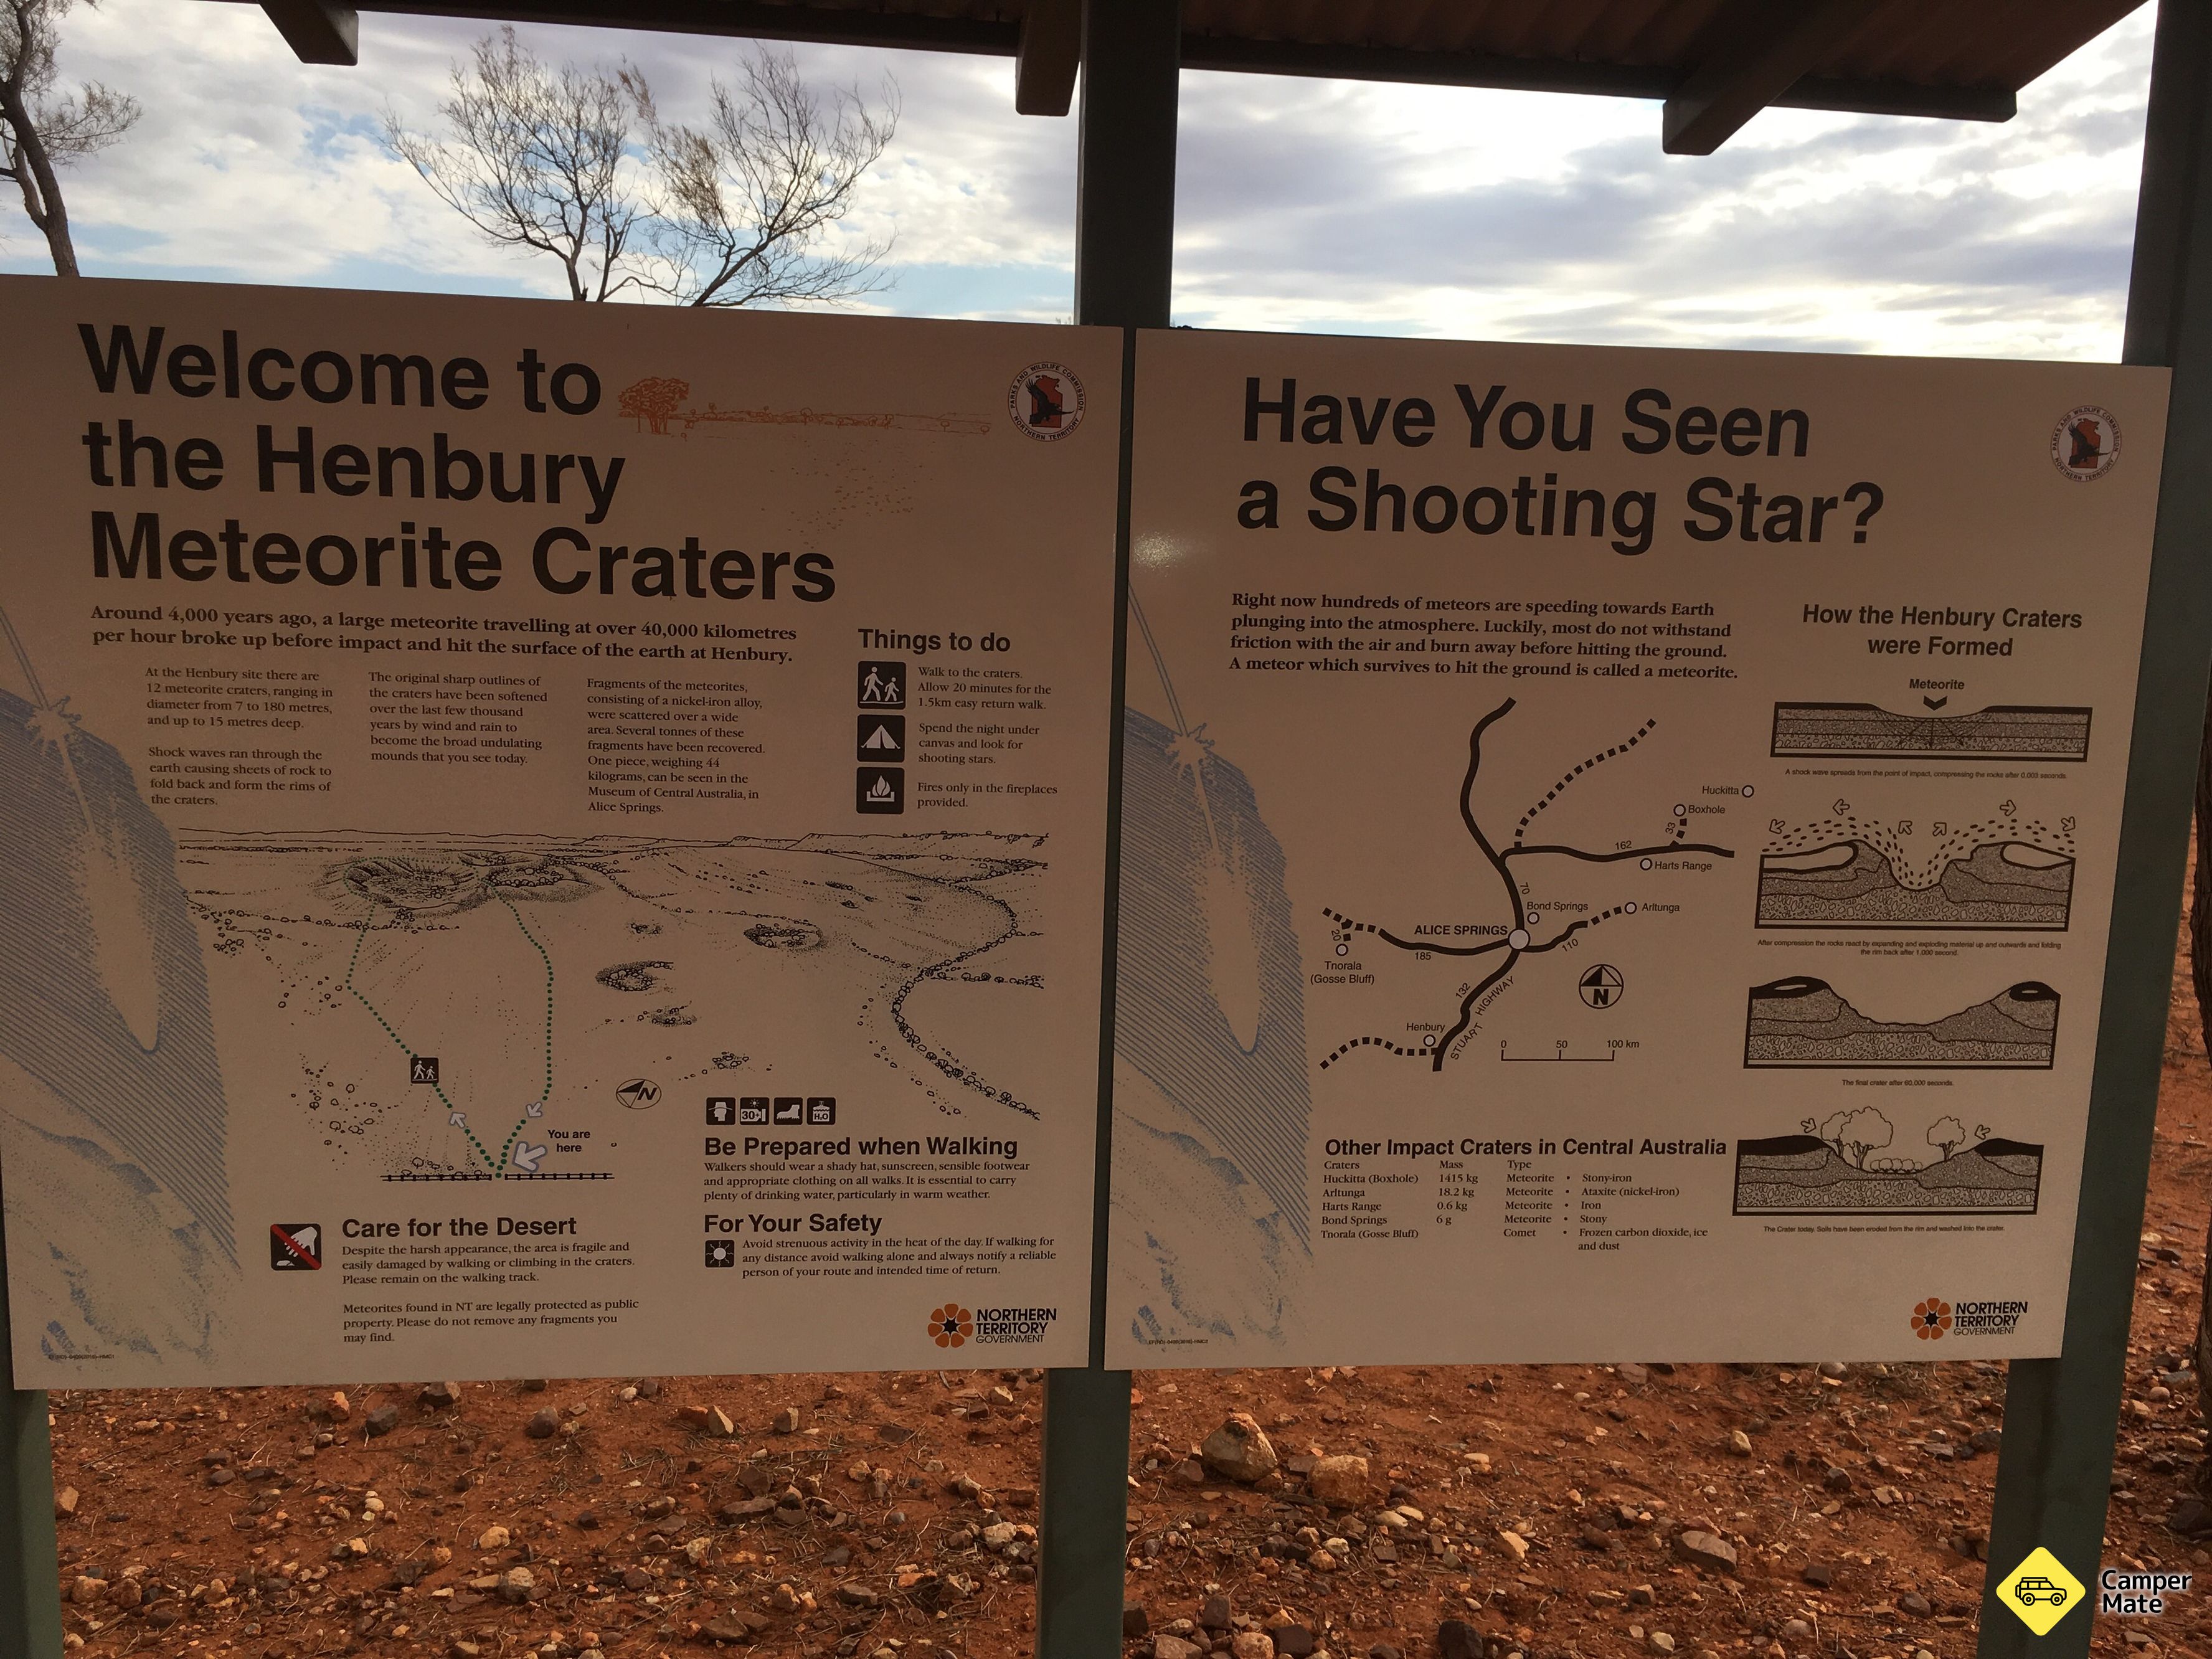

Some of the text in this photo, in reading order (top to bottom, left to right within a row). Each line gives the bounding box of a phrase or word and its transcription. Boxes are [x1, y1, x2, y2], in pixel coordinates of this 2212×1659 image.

[77, 323, 600, 415] Welcome to
[1018, 371, 1028, 384] AND
[1062, 369, 1084, 410] COMMISSION
[1244, 377, 1809, 456] Have You Seen
[1014, 416, 1079, 440] NORTHERN TERRITORY
[82, 419, 626, 524] the Henbury
[1237, 466, 1883, 555] a Shooting Star?
[92, 511, 835, 602] Meteorite Craters
[1232, 593, 1714, 617] Right now hundreds of meteors are speeding towards Earth
[91, 606, 796, 640] Around 4,000 years ago, a large meteorite travelling at over 40,000 kilometres
[1803, 604, 2082, 631] How the Henbury Craters
[858, 629, 1010, 655] Things to do
[1868, 636, 2013, 656] were Formed
[145, 668, 158, 676] At
[162, 668, 182, 677] the
[186, 668, 238, 681] Henbury
[242, 670, 262, 679] site
[267, 670, 297, 680] there
[918, 667, 945, 676] Walk
[963, 668, 980, 677] the
[983, 670, 1023, 678] craters.
[1909, 679, 1964, 689] Meteorite
[1703, 786, 1739, 795] Huckitta
[1688, 805, 1725, 813] Boxhole
[1615, 841, 1632, 849] 162
[1655, 861, 1712, 872] Harts Range
[1527, 902, 1588, 912] Bond Springs
[1642, 903, 1680, 914] Arltunga
[1414, 925, 1508, 935] ALICE SPRINGS
[1416, 952, 1431, 960] 185
[1325, 961, 1361, 970] Tnorala
[1310, 974, 1374, 985] (Gosse Bluff)
[1456, 983, 1470, 999] 132
[1450, 976, 1515, 1060] STUART HIGHWAY
[1407, 1023, 1445, 1033] Henbury
[1501, 1040, 1506, 1048] 0
[1556, 1040, 1567, 1048] 50
[1607, 1040, 1623, 1048] 100
[548, 1130, 569, 1138] You
[557, 1143, 582, 1152] here
[706, 1137, 1017, 1160] Be Prepared when Walking
[1325, 1138, 1726, 1159] Other Impact Craters in Central Australia
[704, 1163, 746, 1171] Walkers
[750, 1162, 785, 1171] should
[827, 1162, 857, 1173] shady
[861, 1162, 879, 1171] hat,
[939, 1161, 980, 1170] sensible
[984, 1161, 1030, 1170] footwear
[1324, 1161, 1359, 1169] Craters
[1507, 1160, 1531, 1171] Type
[1323, 1174, 1419, 1184] Huckitta (Boxhole)
[1440, 1173, 1478, 1184] 1415 kg
[1507, 1174, 1554, 1182] Meteorite
[1582, 1173, 1632, 1184] Stony-iron
[1323, 1188, 1365, 1198] Arltunga
[1462, 1188, 1474, 1198] kg
[1506, 1188, 1553, 1196] Meteorite
[1582, 1187, 1679, 1197] Ataxite (nickel-iron)
[1323, 1203, 1381, 1212] Harts Range
[1437, 1201, 1467, 1212] 0.6 kg
[1506, 1201, 1553, 1209] Meteorite
[1582, 1201, 1600, 1209] Iron
[343, 1217, 577, 1238] Care for the Desert
[705, 1213, 882, 1236] For Your Safety
[1359, 1231, 1390, 1239] (Gosse
[1393, 1229, 1419, 1238] Bluff)
[1503, 1229, 1536, 1237] Comet
[1579, 1228, 1612, 1236] Frozen
[1615, 1228, 1649, 1236] carbon
[1652, 1228, 1691, 1237] dioxide,
[1578, 1242, 1619, 1250] and dust
[1956, 1302, 2028, 1315] NORTHERN
[977, 1308, 1056, 1321] NORTHERN
[1955, 1315, 2019, 1327] TERRITORY
[976, 1322, 1048, 1335] TERRITORY
[1954, 1326, 2015, 1335] GOVERNMENT
[976, 1335, 1044, 1343] GOVERNMENT
